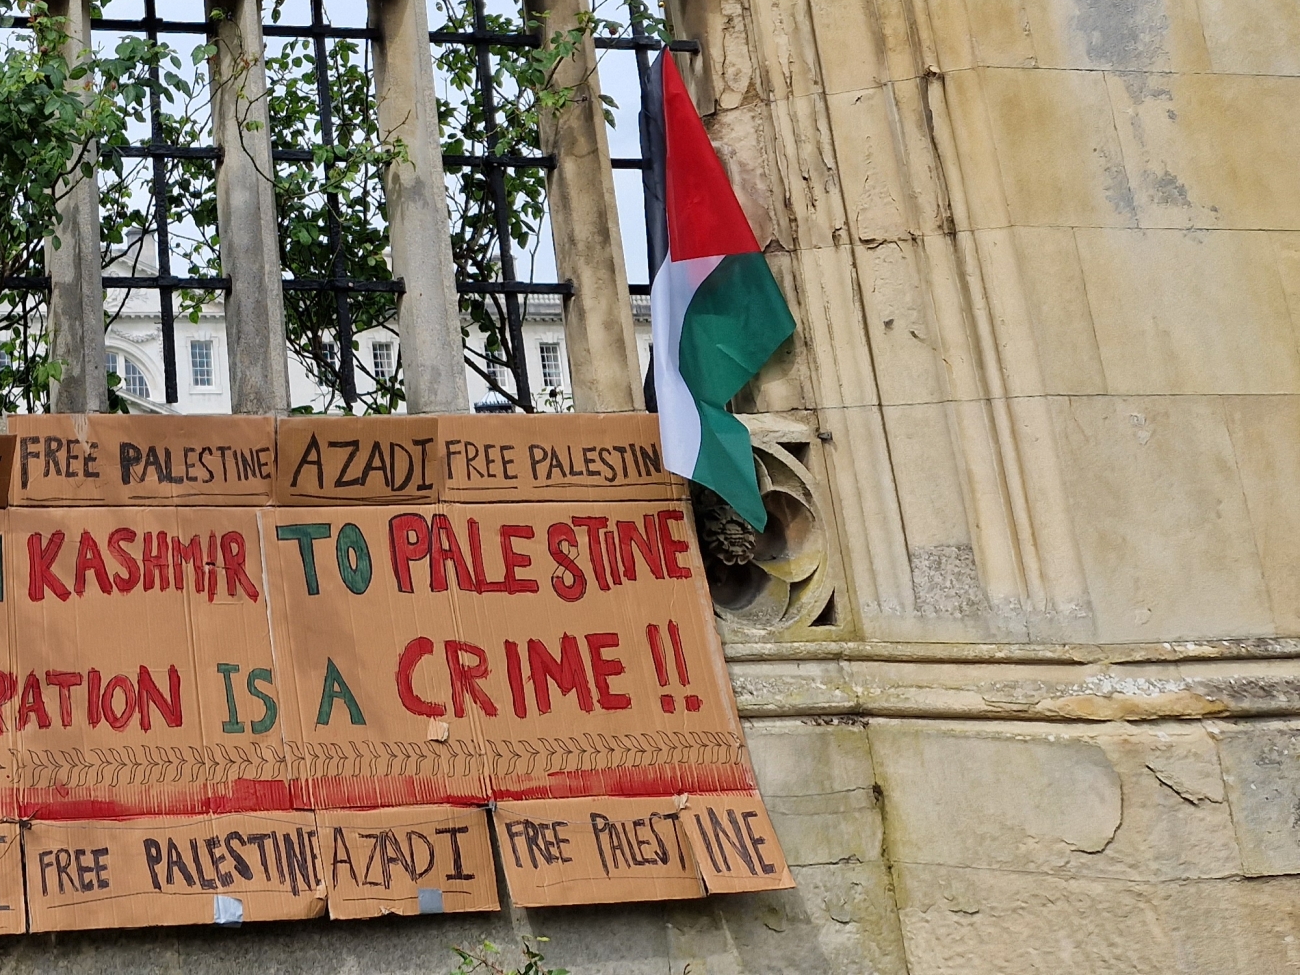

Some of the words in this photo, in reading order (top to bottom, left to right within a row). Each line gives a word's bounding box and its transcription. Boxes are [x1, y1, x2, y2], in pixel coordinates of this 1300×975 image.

[20, 435, 100, 491] FREE
[120, 441, 274, 486] PALESTINE
[290, 432, 434, 492] AZADI
[446, 439, 519, 481] FREE
[529, 442, 664, 483] PALESTIN
[27, 527, 260, 604] KASHMIR
[276, 522, 373, 596] TO
[388, 509, 693, 602] PALESTINE
[216, 662, 277, 735] IS
[315, 657, 366, 731] A
[40, 846, 111, 897] FREE
[143, 827, 323, 897] PALESTINE
[332, 826, 475, 891] AZADI
[505, 820, 574, 870] FREE
